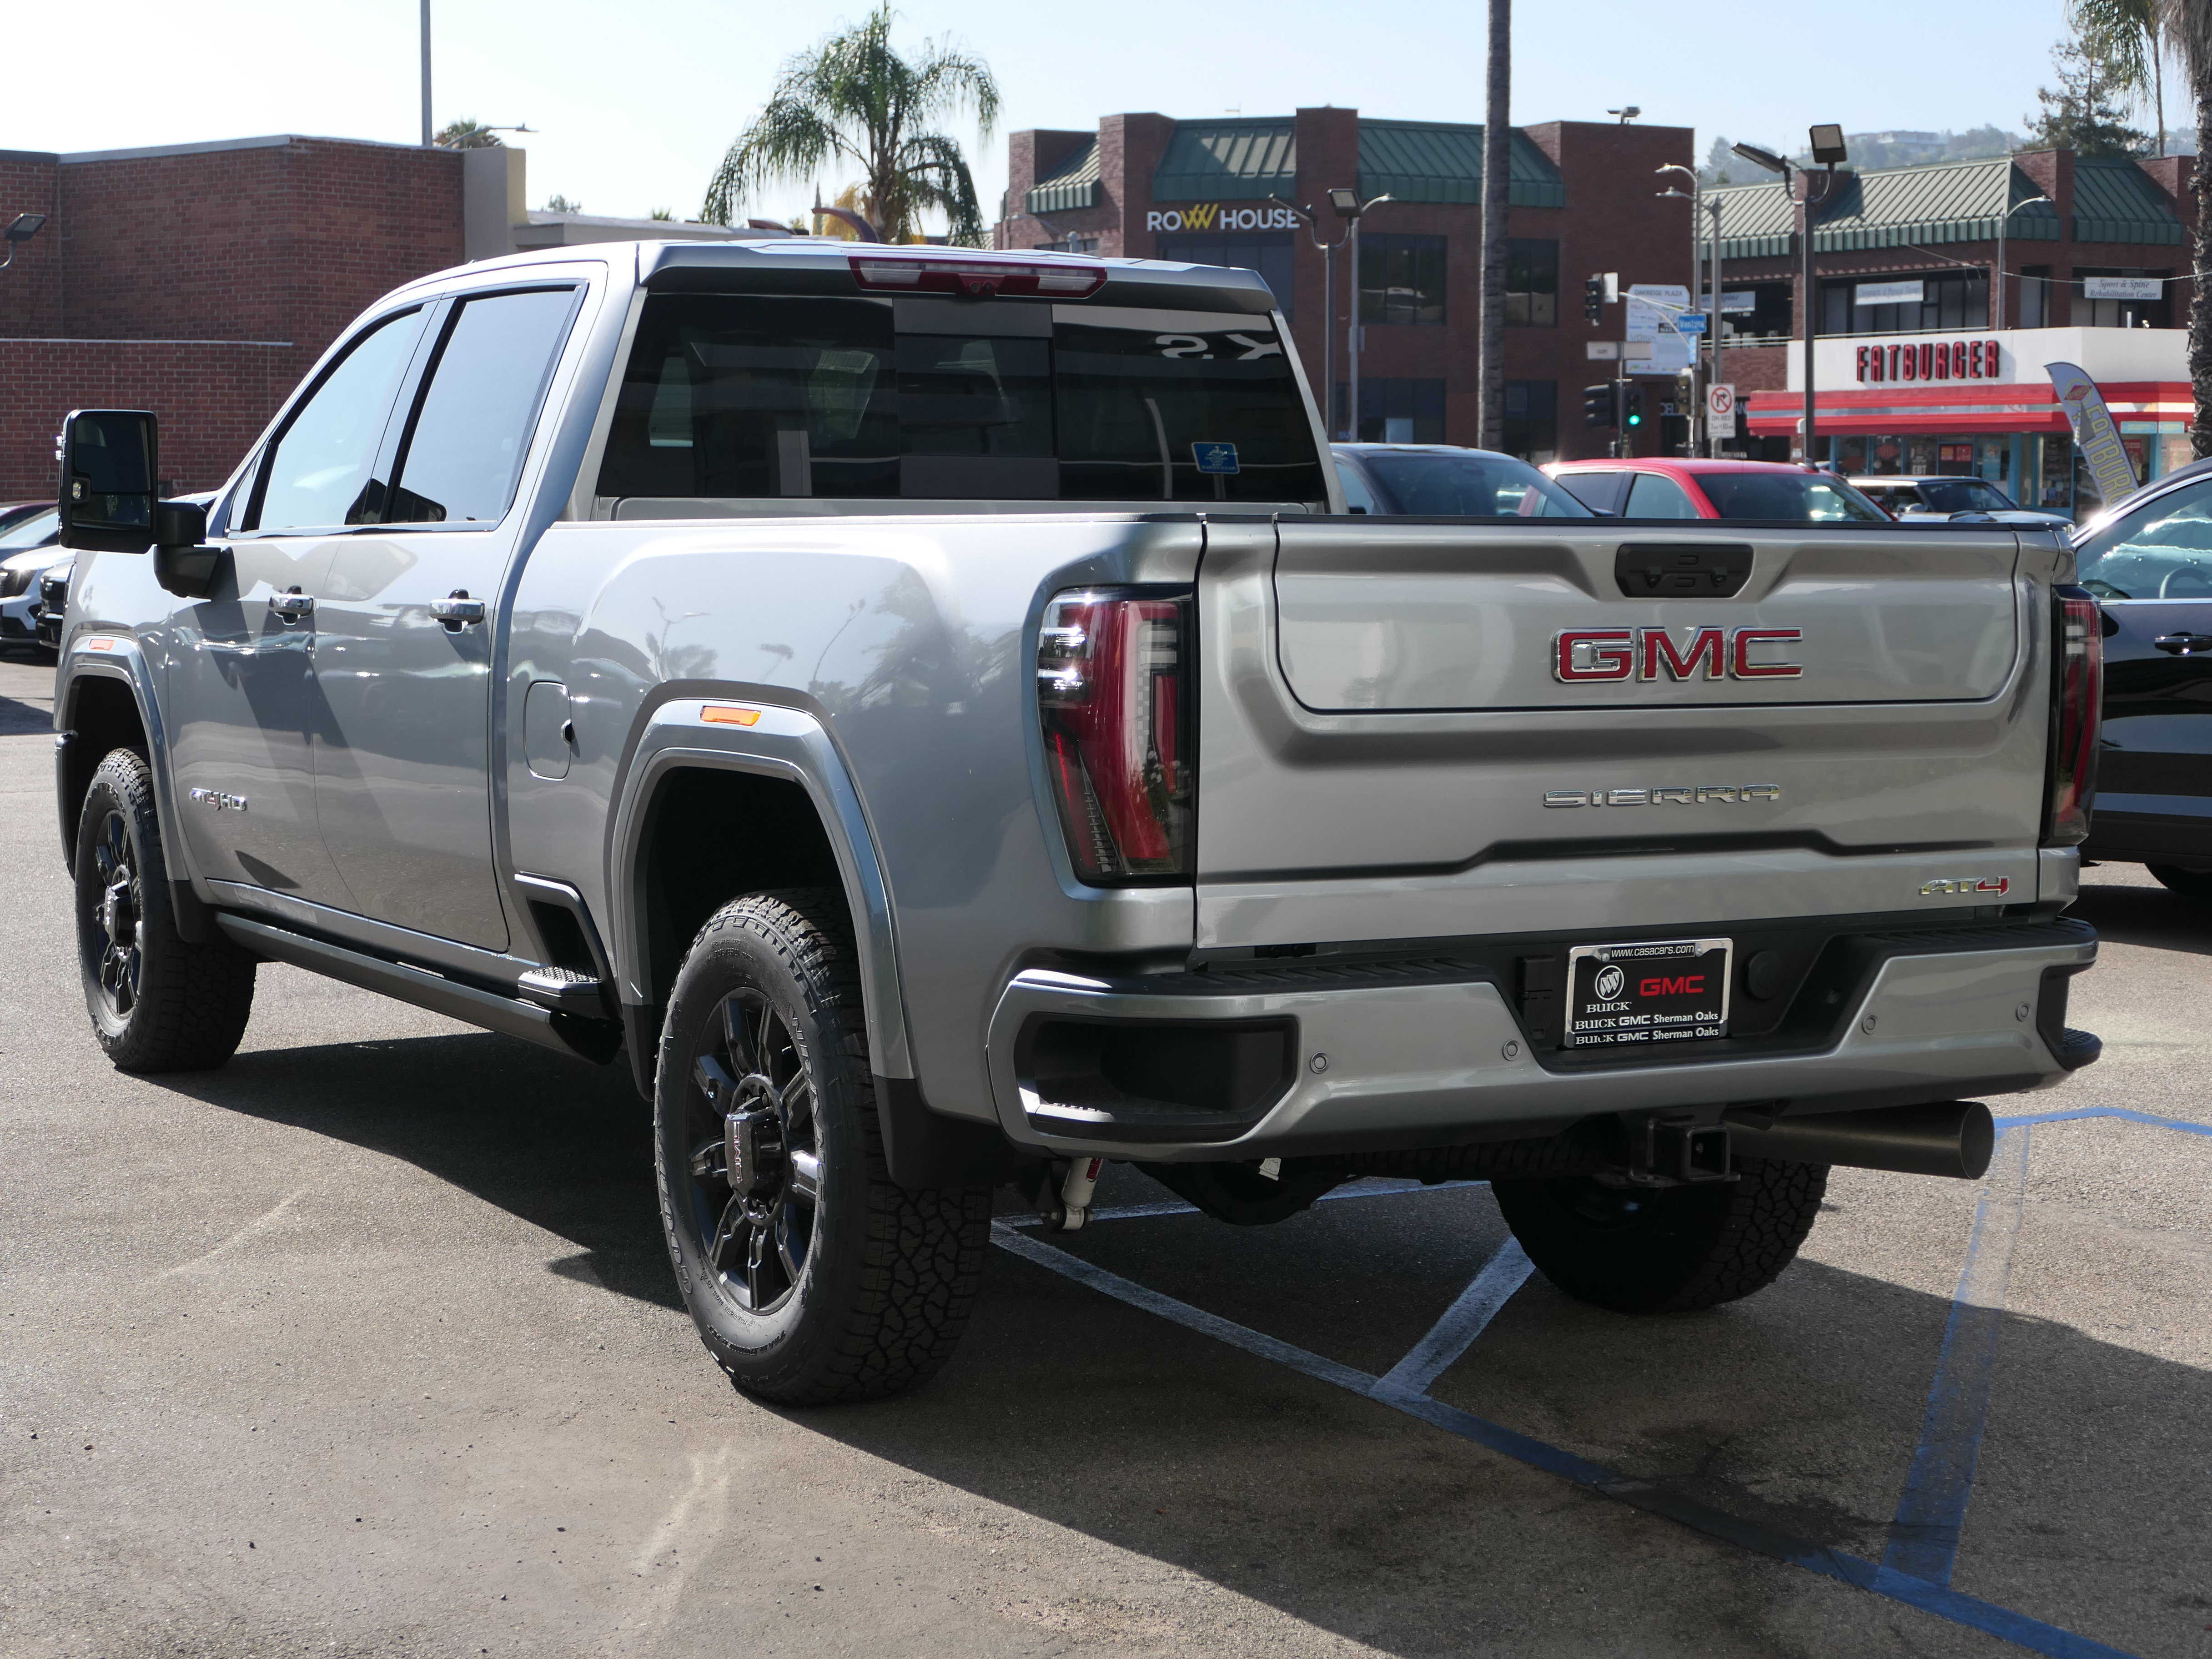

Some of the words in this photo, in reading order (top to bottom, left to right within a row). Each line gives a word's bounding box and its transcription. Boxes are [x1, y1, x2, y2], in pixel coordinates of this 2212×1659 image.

[1147, 203, 1219, 232] ROW
[1220, 208, 1300, 229] HOUSE
[2090, 290, 2135, 298] Rehabilitation
[2136, 290, 2157, 298] Center
[2098, 279, 2118, 289] Sport
[2129, 280, 2150, 290] Spine
[1679, 320, 1705, 328] Ventura
[1856, 340, 2000, 382] FATBURGER
[1551, 626, 1803, 684] GMC
[1543, 784, 1780, 808] SIERRA
[1919, 876, 2010, 897] AT4
[1612, 944, 1694, 958] www.casacars.com
[1639, 975, 1705, 997] GMC
[1586, 1001, 1630, 1013] BUICK
[1575, 1018, 1617, 1030] BUICK
[1619, 1015, 1651, 1026] GMC
[1654, 1014, 1693, 1024] Sherman
[1695, 1011, 1719, 1021] Oaks
[1575, 1034, 1614, 1045] BUICK
[1617, 1031, 1649, 1042] GMC
[1653, 1029, 1693, 1040] Sherman
[1695, 1027, 1719, 1037] Oaks
